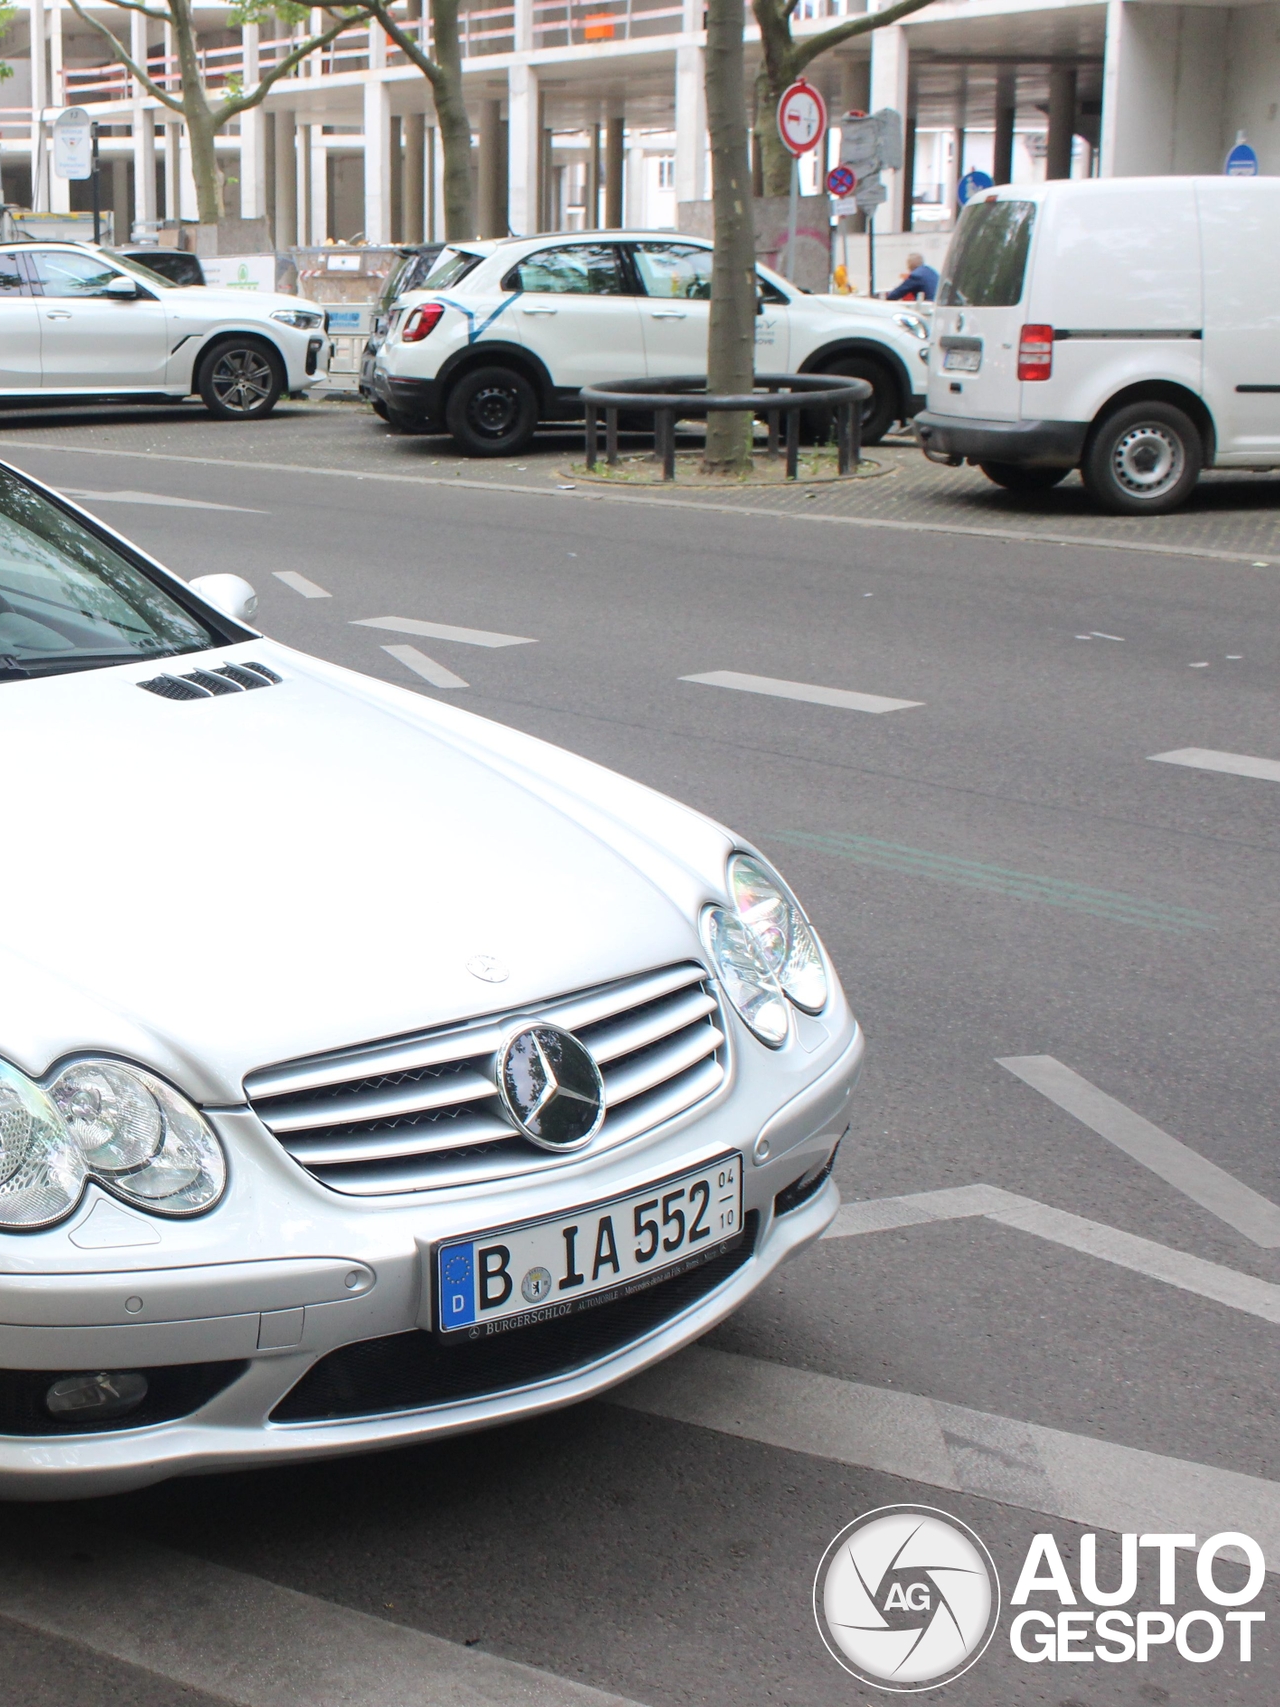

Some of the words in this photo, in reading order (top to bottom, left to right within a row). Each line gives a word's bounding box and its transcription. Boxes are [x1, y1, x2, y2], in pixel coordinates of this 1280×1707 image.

[719, 1167, 734, 1188] 04
[720, 1208, 734, 1229] 10
[478, 1244, 514, 1312] B
[558, 1215, 621, 1291] IA
[633, 1179, 711, 1264] 552
[452, 1294, 465, 1314] D
[485, 1302, 572, 1336] BURGERSCHLOZ
[577, 1290, 619, 1312] AUTOMOBILE
